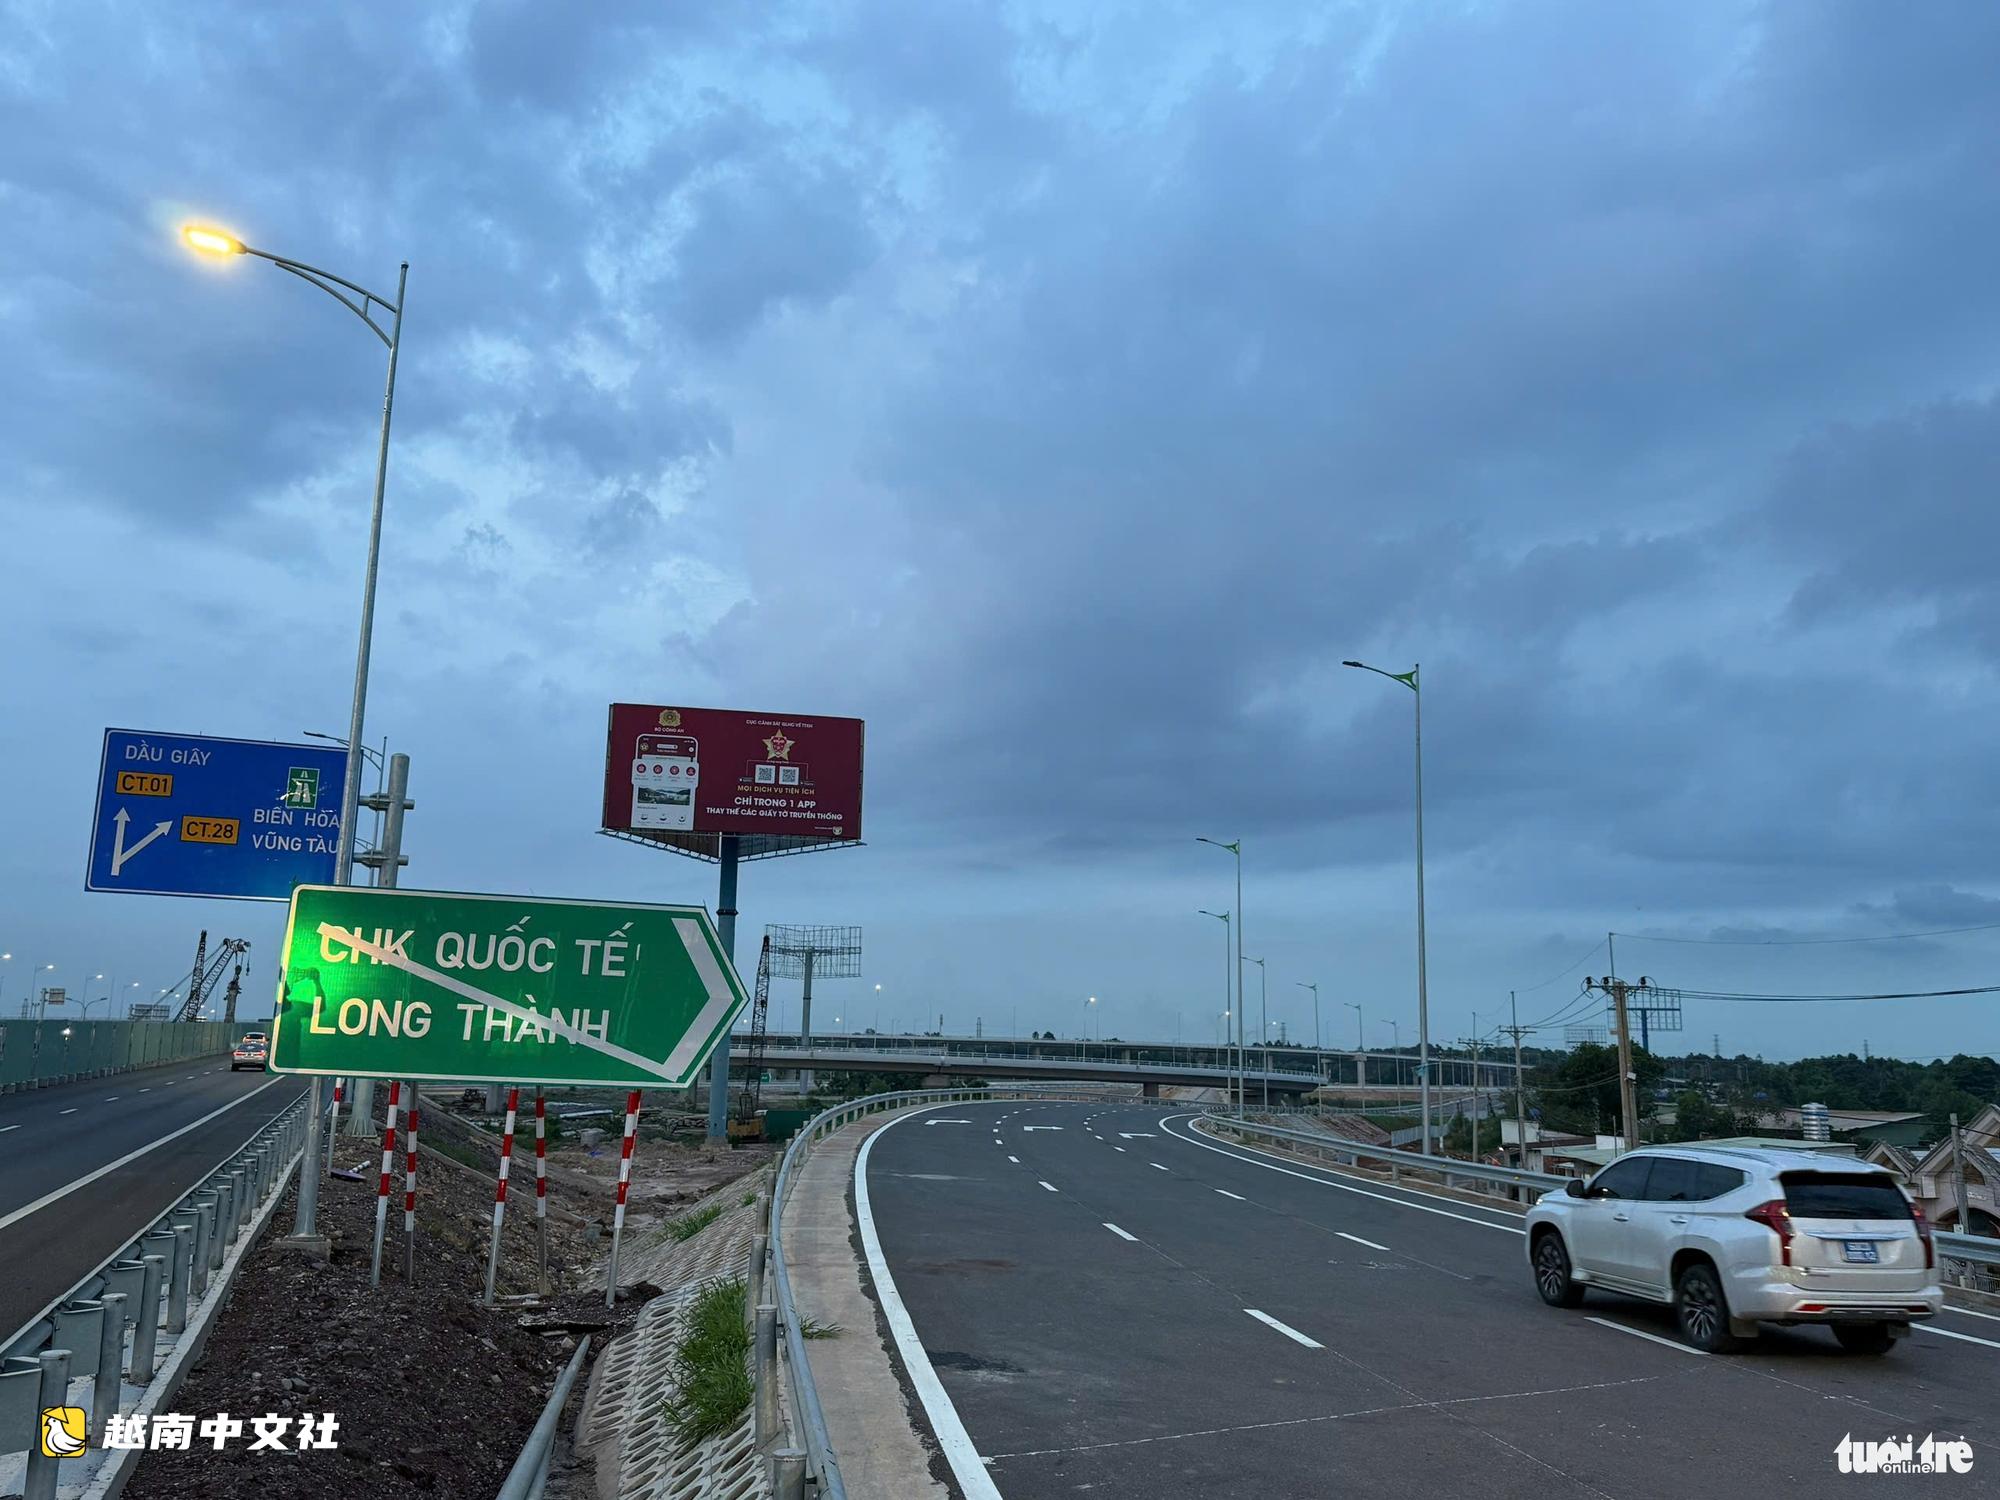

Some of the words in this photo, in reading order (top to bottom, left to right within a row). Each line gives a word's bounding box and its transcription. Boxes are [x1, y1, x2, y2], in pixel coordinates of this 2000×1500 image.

[125, 740, 164, 762] DẦU
[170, 748, 211, 767] GIÂY
[122, 774, 168, 793] CT.01
[734, 796, 752, 805] CHỈ
[754, 798, 786, 807] TRONG
[797, 800, 816, 809] APP
[254, 806, 293, 826] BIÊN
[726, 807, 740, 815] THẾ
[759, 808, 777, 817] GIẤY
[817, 811, 843, 820] THỐNG
[186, 821, 234, 840] CT.28
[252, 831, 302, 852] VŨNG
[306, 836, 338, 854] TÀU
[320, 925, 415, 966] CHK
[434, 916, 556, 973] QUỐC
[576, 922, 635, 977] TẾ
[310, 996, 432, 1039] LONG
[456, 994, 610, 1045] THÀNH
